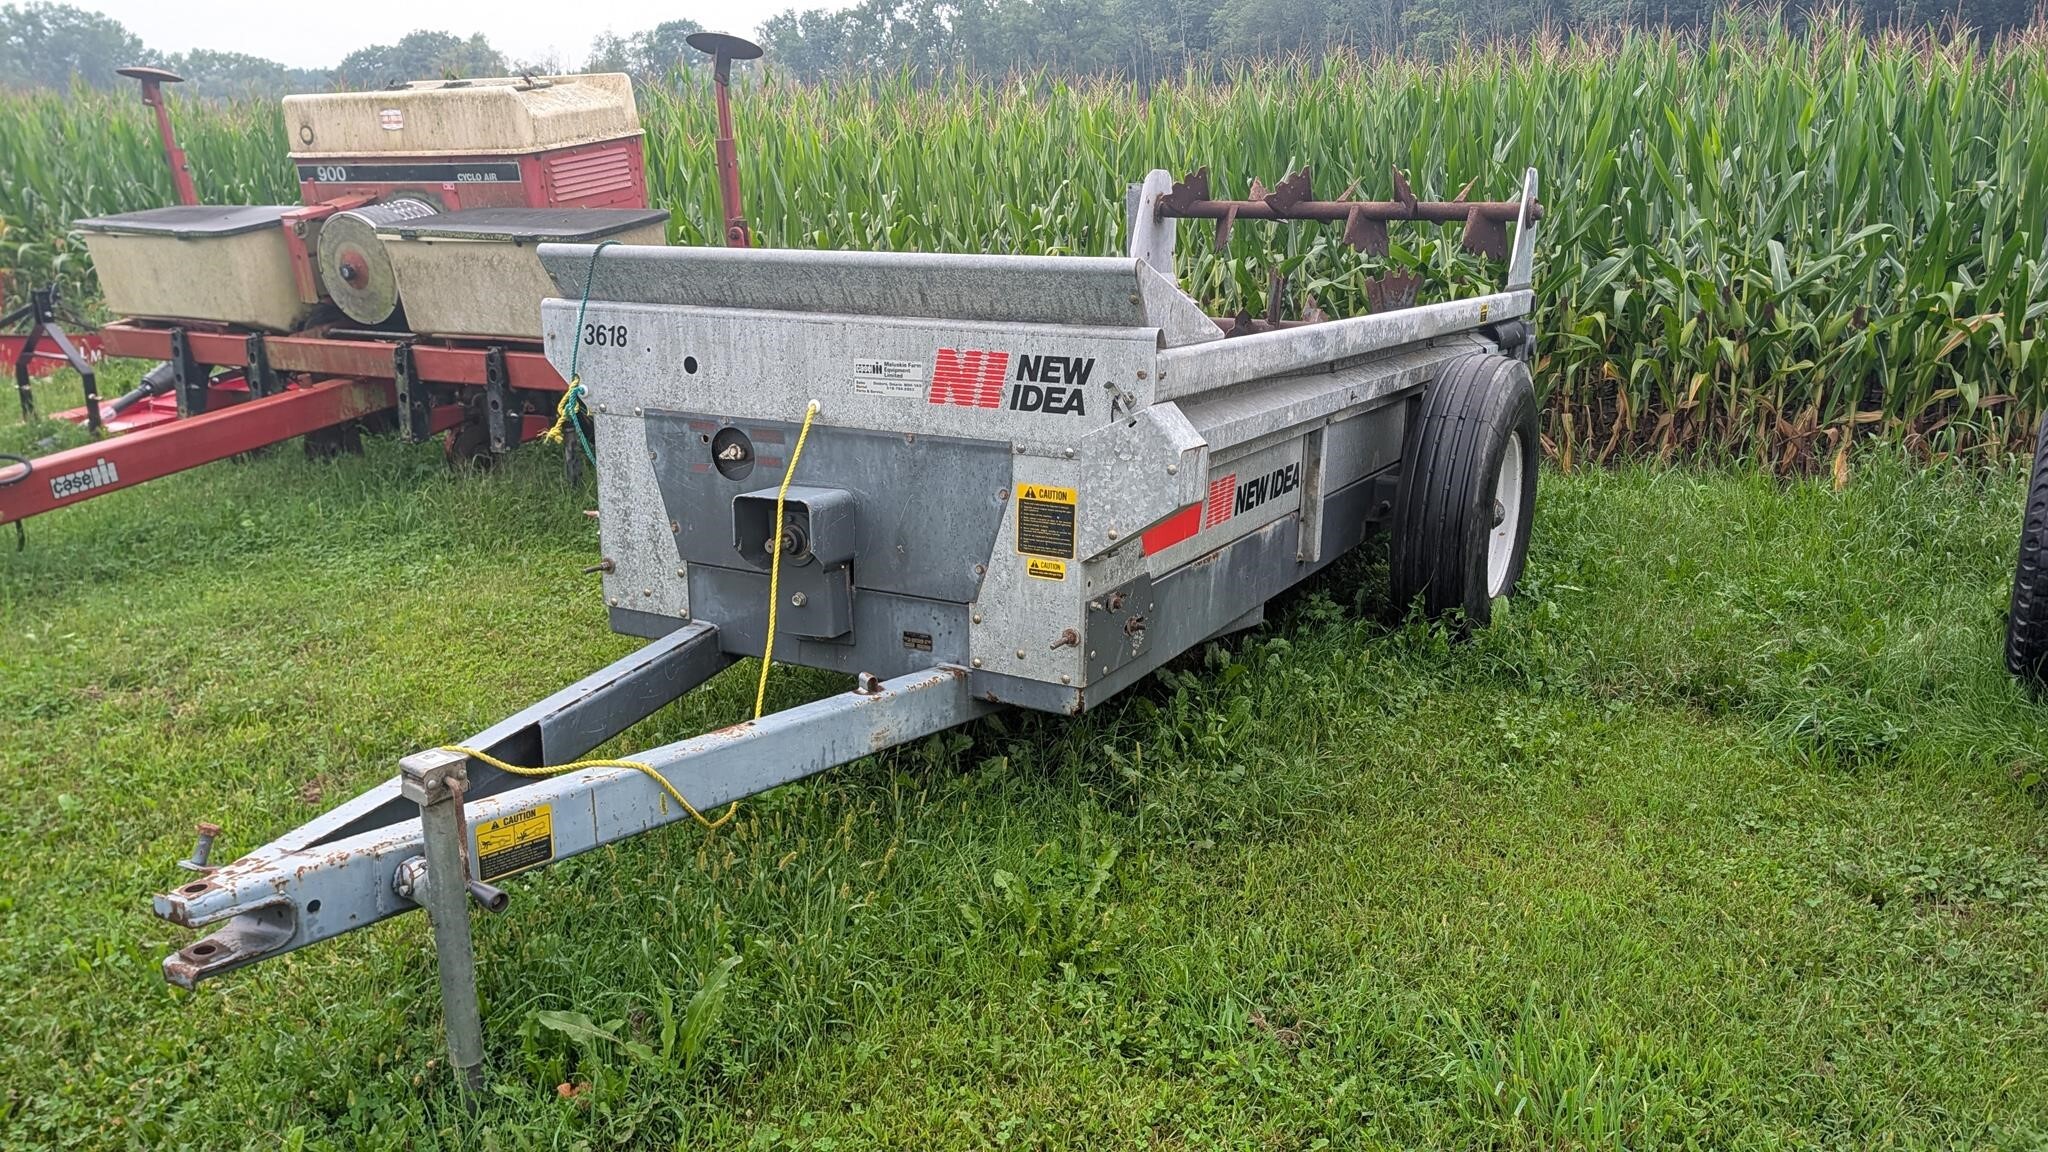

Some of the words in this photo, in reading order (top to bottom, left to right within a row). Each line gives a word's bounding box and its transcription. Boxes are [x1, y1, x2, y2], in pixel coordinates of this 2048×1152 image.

[317, 166, 347, 182] 900
[457, 173, 482, 182] CYCLO
[484, 172, 498, 181] AIR
[584, 324, 628, 347] 3618
[1016, 354, 1096, 386] NEW
[1009, 384, 1086, 416] IDEA
[1039, 488, 1068, 501] CAUTION
[1234, 474, 1270, 517] NEW
[1269, 461, 1300, 501] IDEA
[1040, 561, 1061, 571] CAUTION
[503, 809, 537, 826] CAUTION
